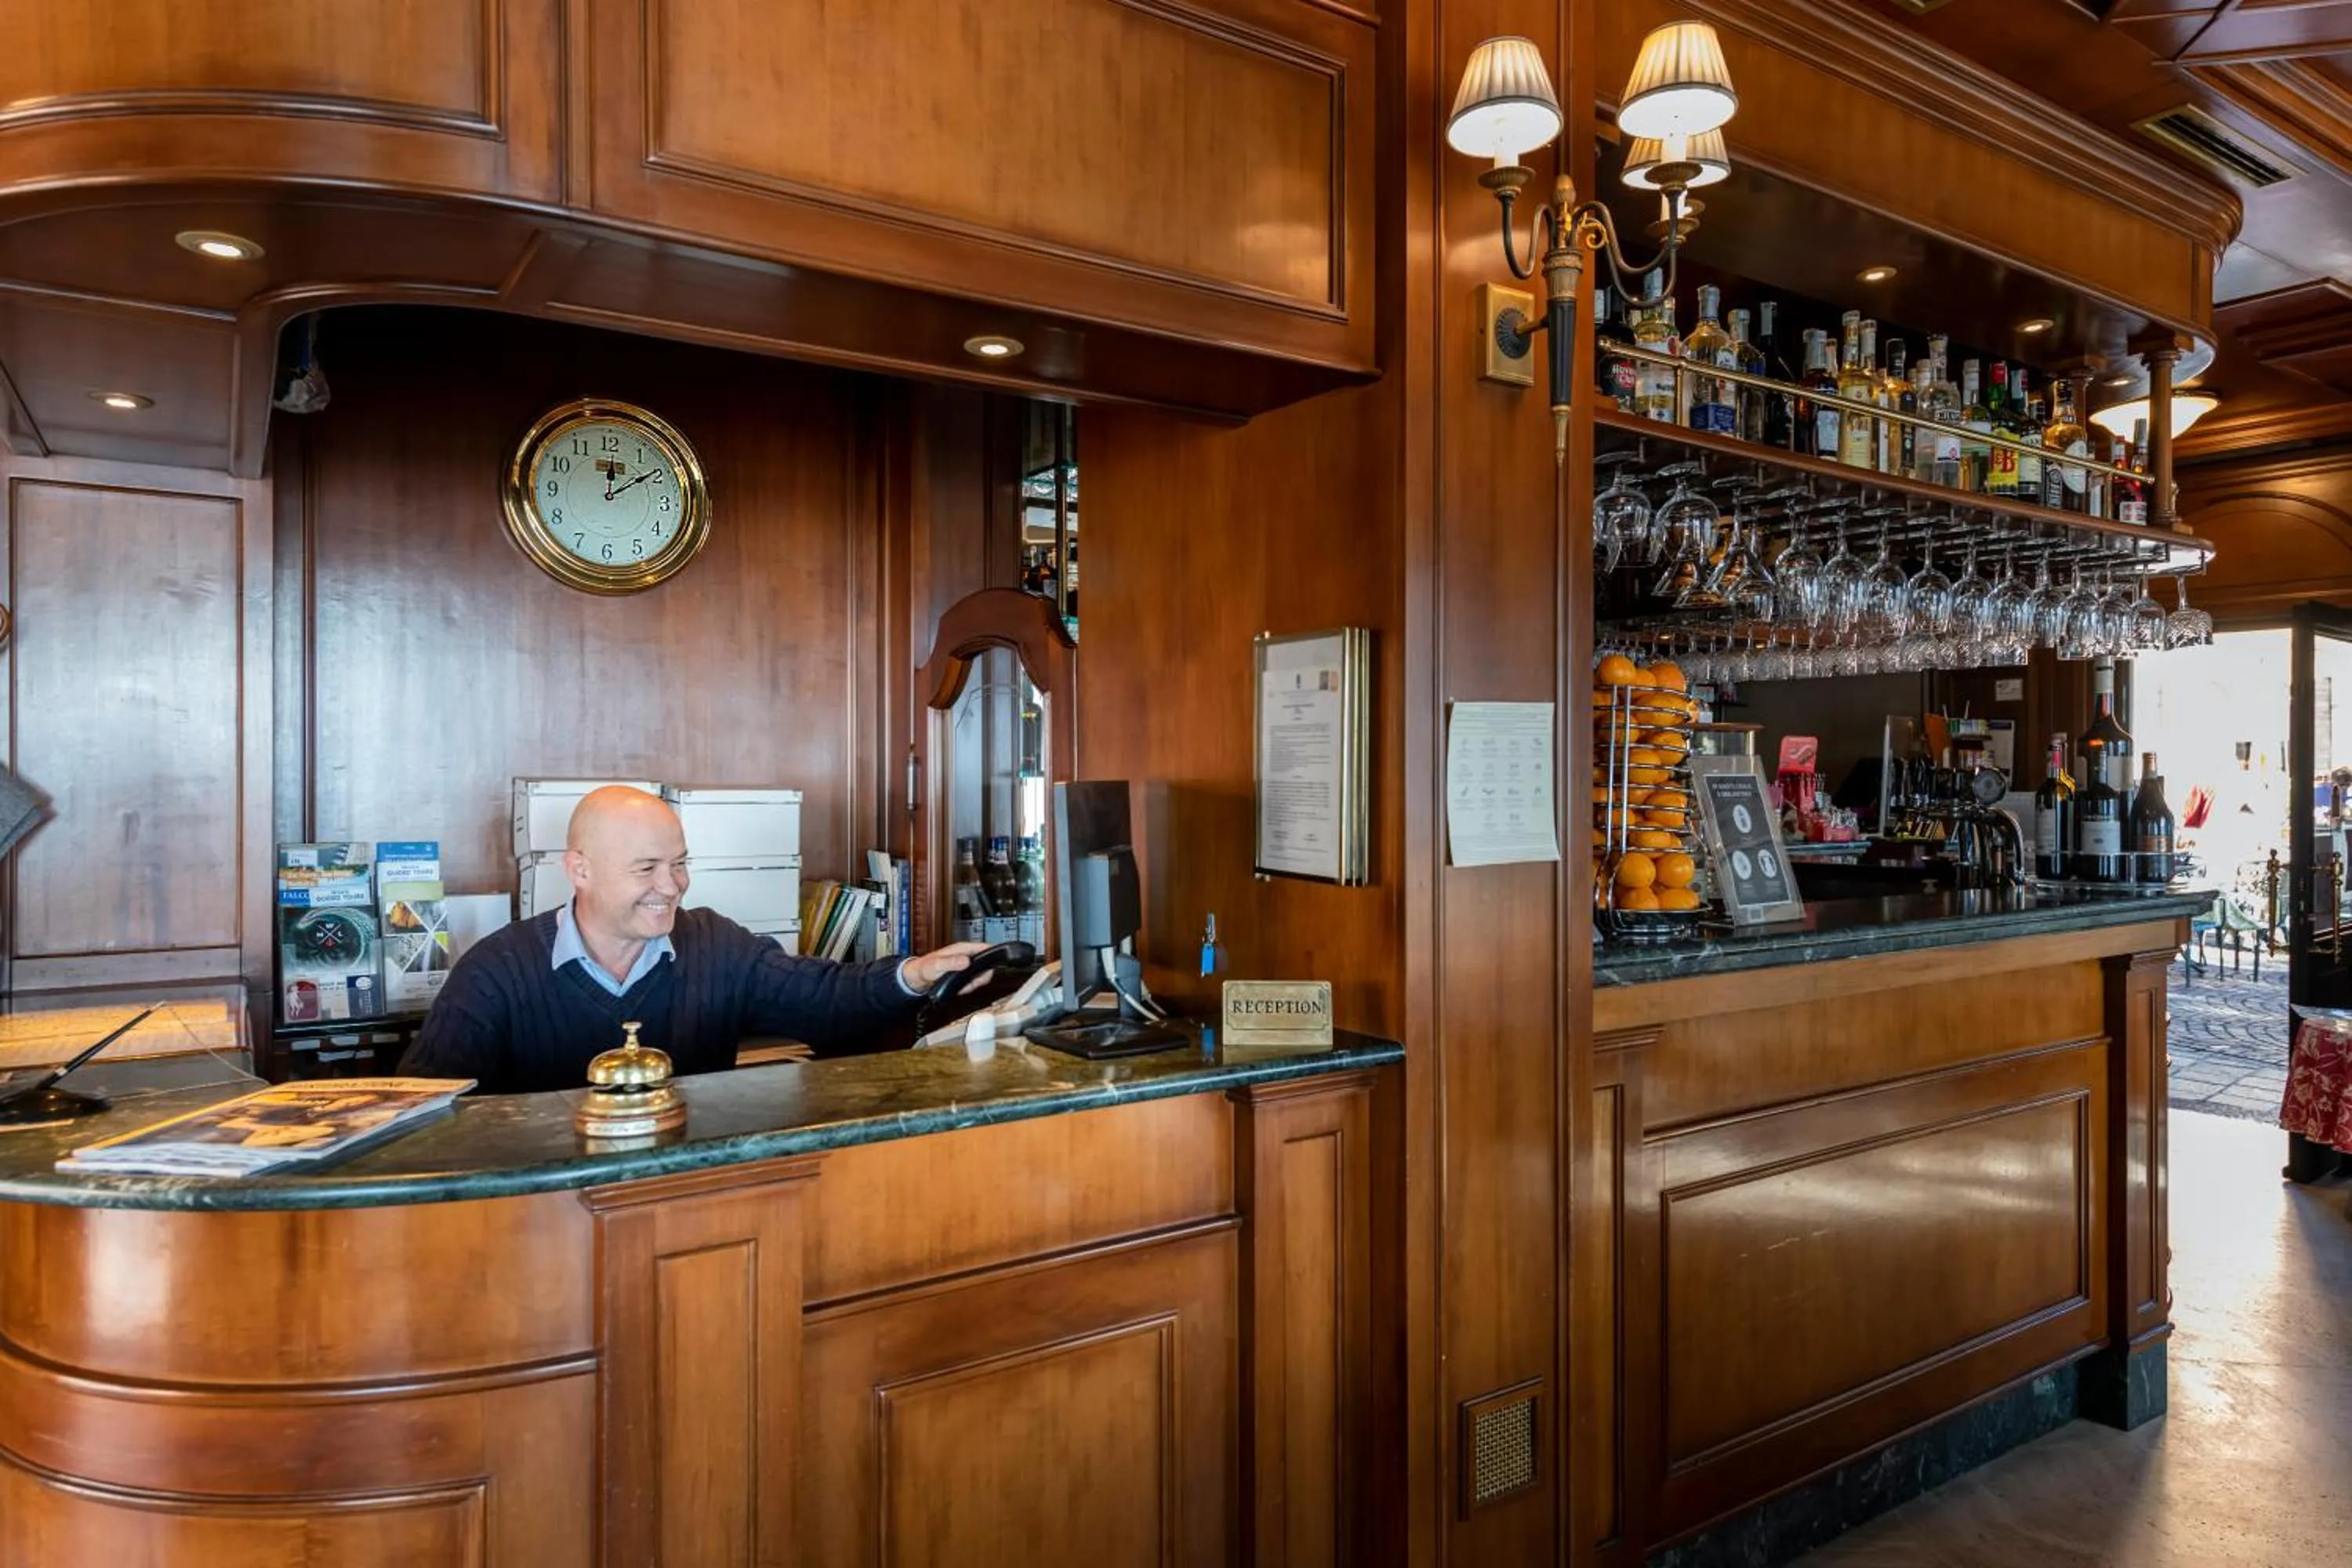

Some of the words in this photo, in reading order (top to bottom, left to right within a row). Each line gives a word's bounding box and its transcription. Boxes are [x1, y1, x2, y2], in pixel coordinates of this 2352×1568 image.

[573, 438, 590, 456] 11
[602, 436, 619, 452] 12
[637, 448, 645, 464] 1
[551, 456, 570, 474] 10
[652, 468, 662, 484] 2
[547, 481, 558, 497] 9
[659, 495, 670, 512] 3
[551, 508, 562, 524] 8
[652, 520, 661, 536] 4
[575, 533, 584, 549] 7
[632, 539, 642, 556] 5
[601, 543, 612, 560] 6
[1232, 1000, 1322, 1014] RECEPTION
